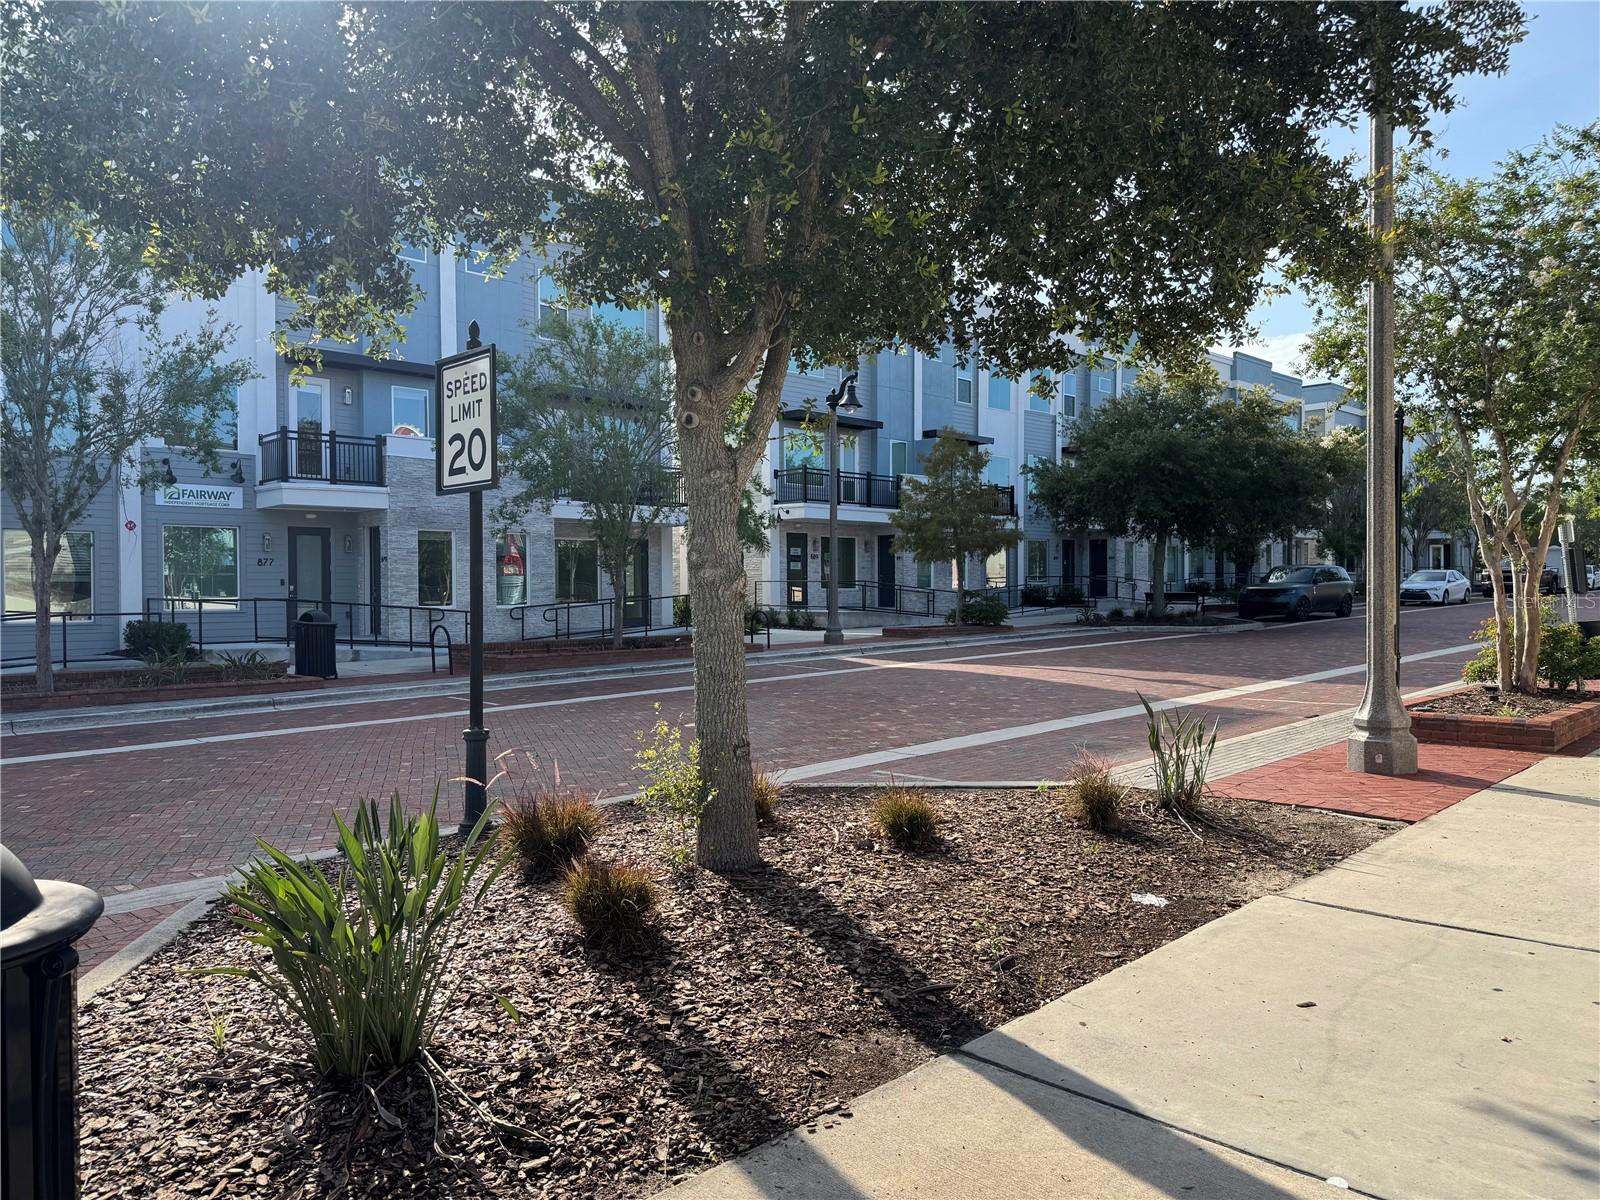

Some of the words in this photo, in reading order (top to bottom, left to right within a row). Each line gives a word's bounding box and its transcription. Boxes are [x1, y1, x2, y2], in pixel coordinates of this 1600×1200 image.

[446, 372, 487, 399] SPEED
[450, 398, 483, 424] LIMIT
[447, 427, 487, 477] 20
[181, 489, 232, 501] FAIRWAY
[256, 558, 274, 567] 877
